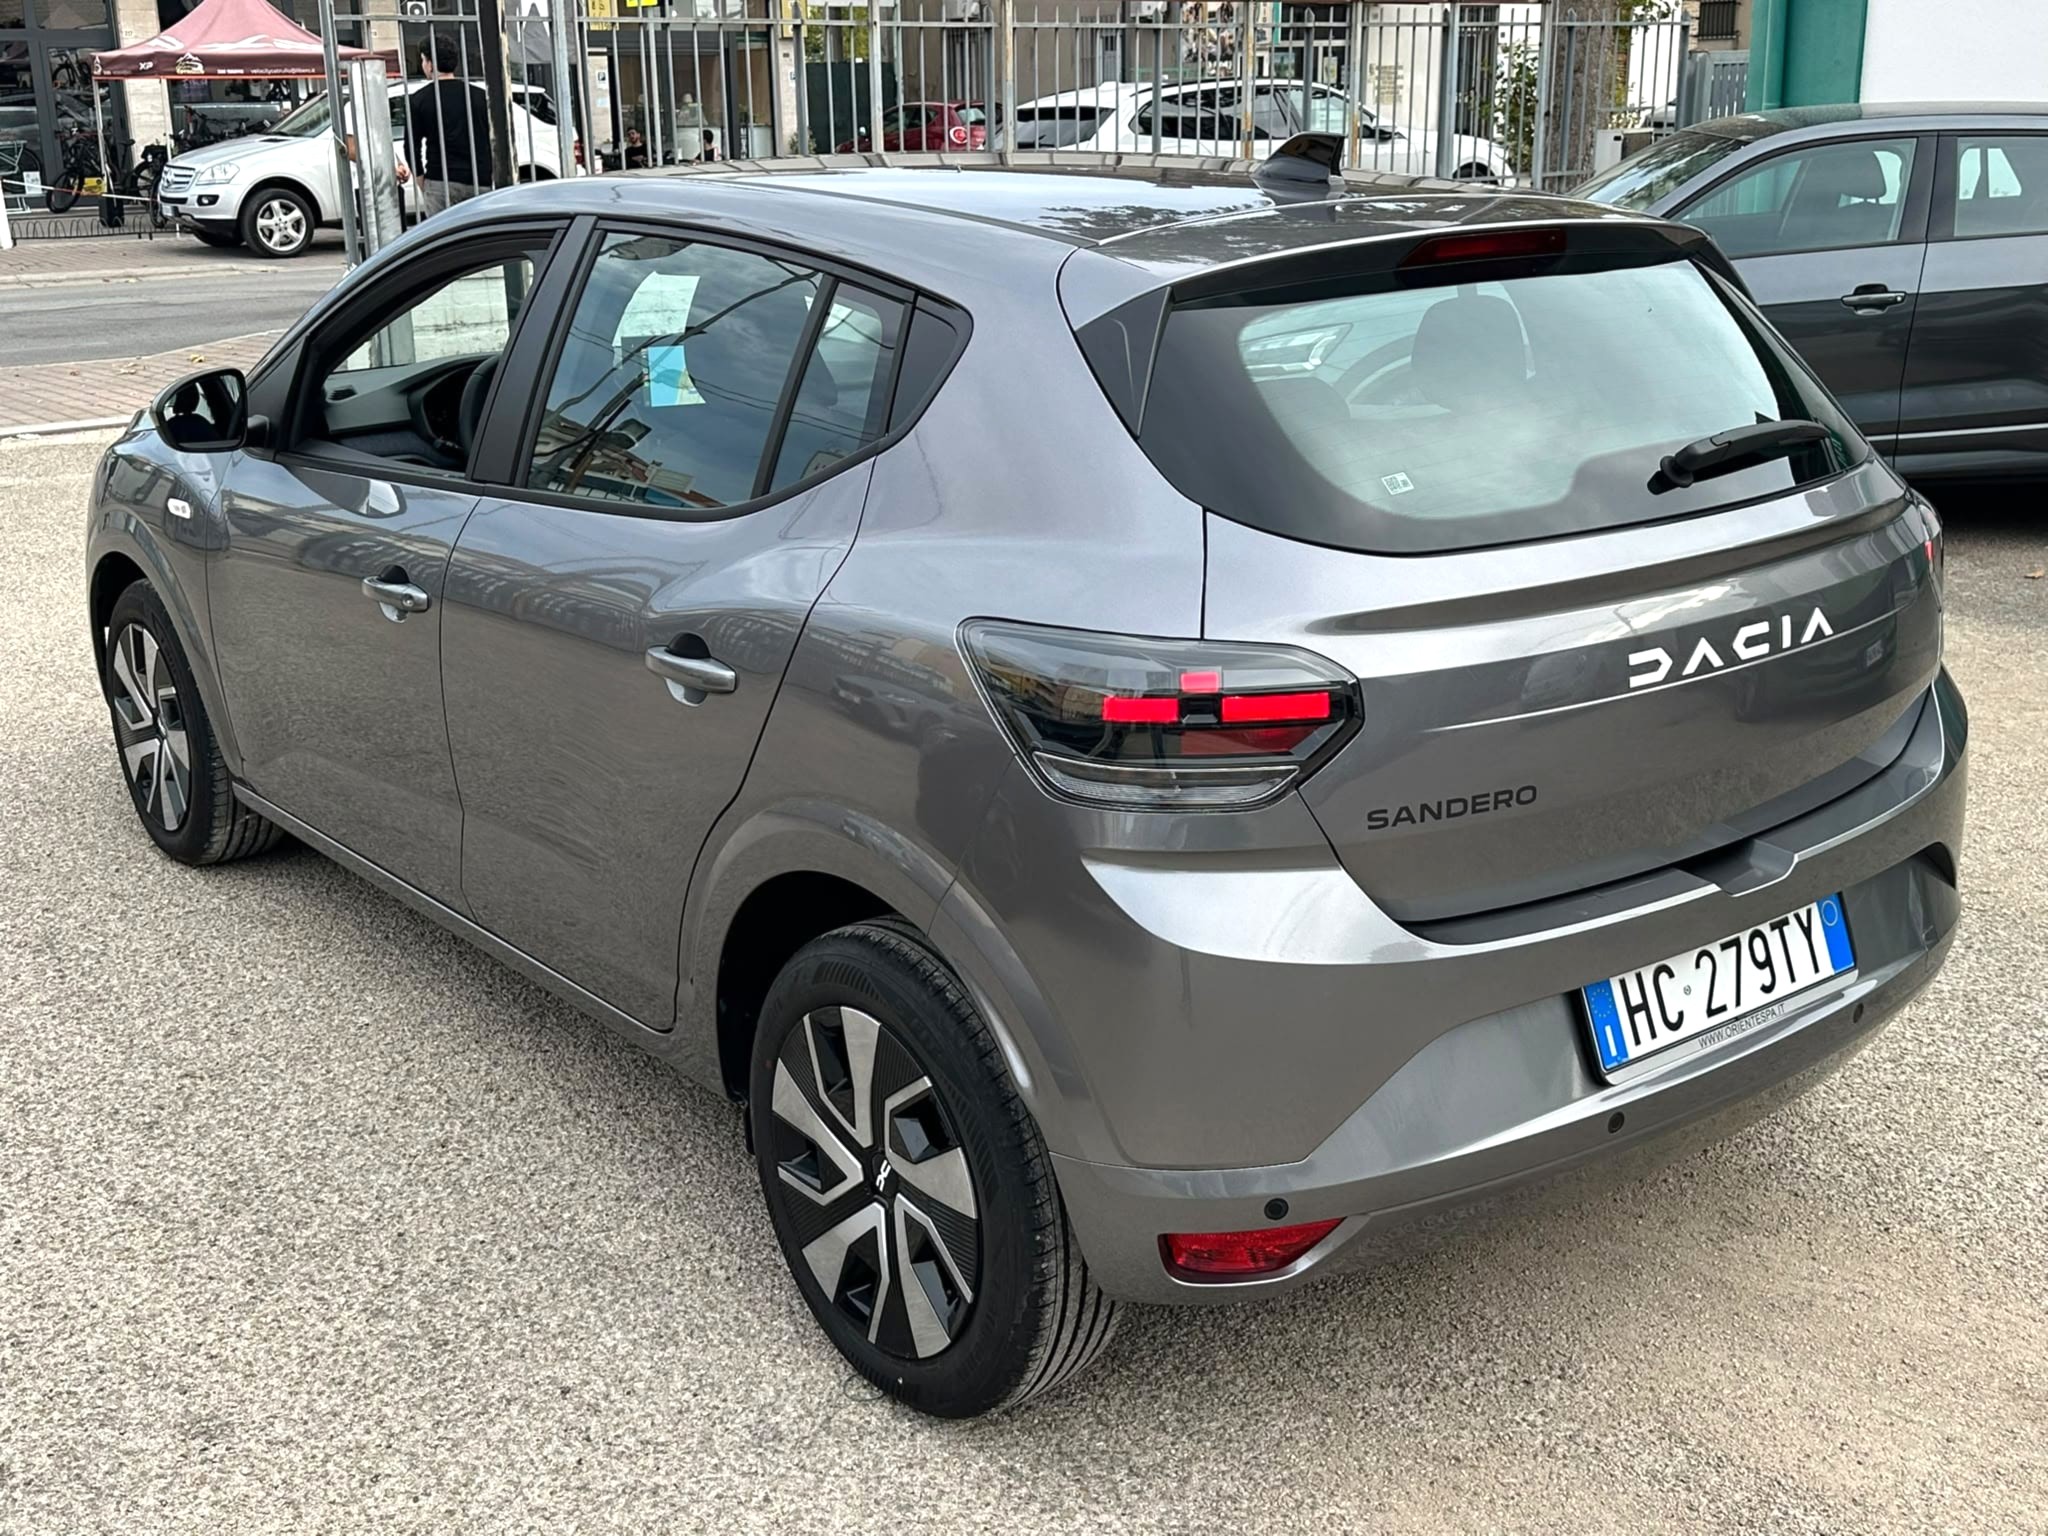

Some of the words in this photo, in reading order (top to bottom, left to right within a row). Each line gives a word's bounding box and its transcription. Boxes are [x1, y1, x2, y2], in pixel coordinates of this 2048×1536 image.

[1628, 606, 1833, 689] DACIA
[1366, 784, 1538, 830] SANDERO
[1618, 963, 1684, 1047] HC
[1695, 906, 1821, 1018] 279TY
